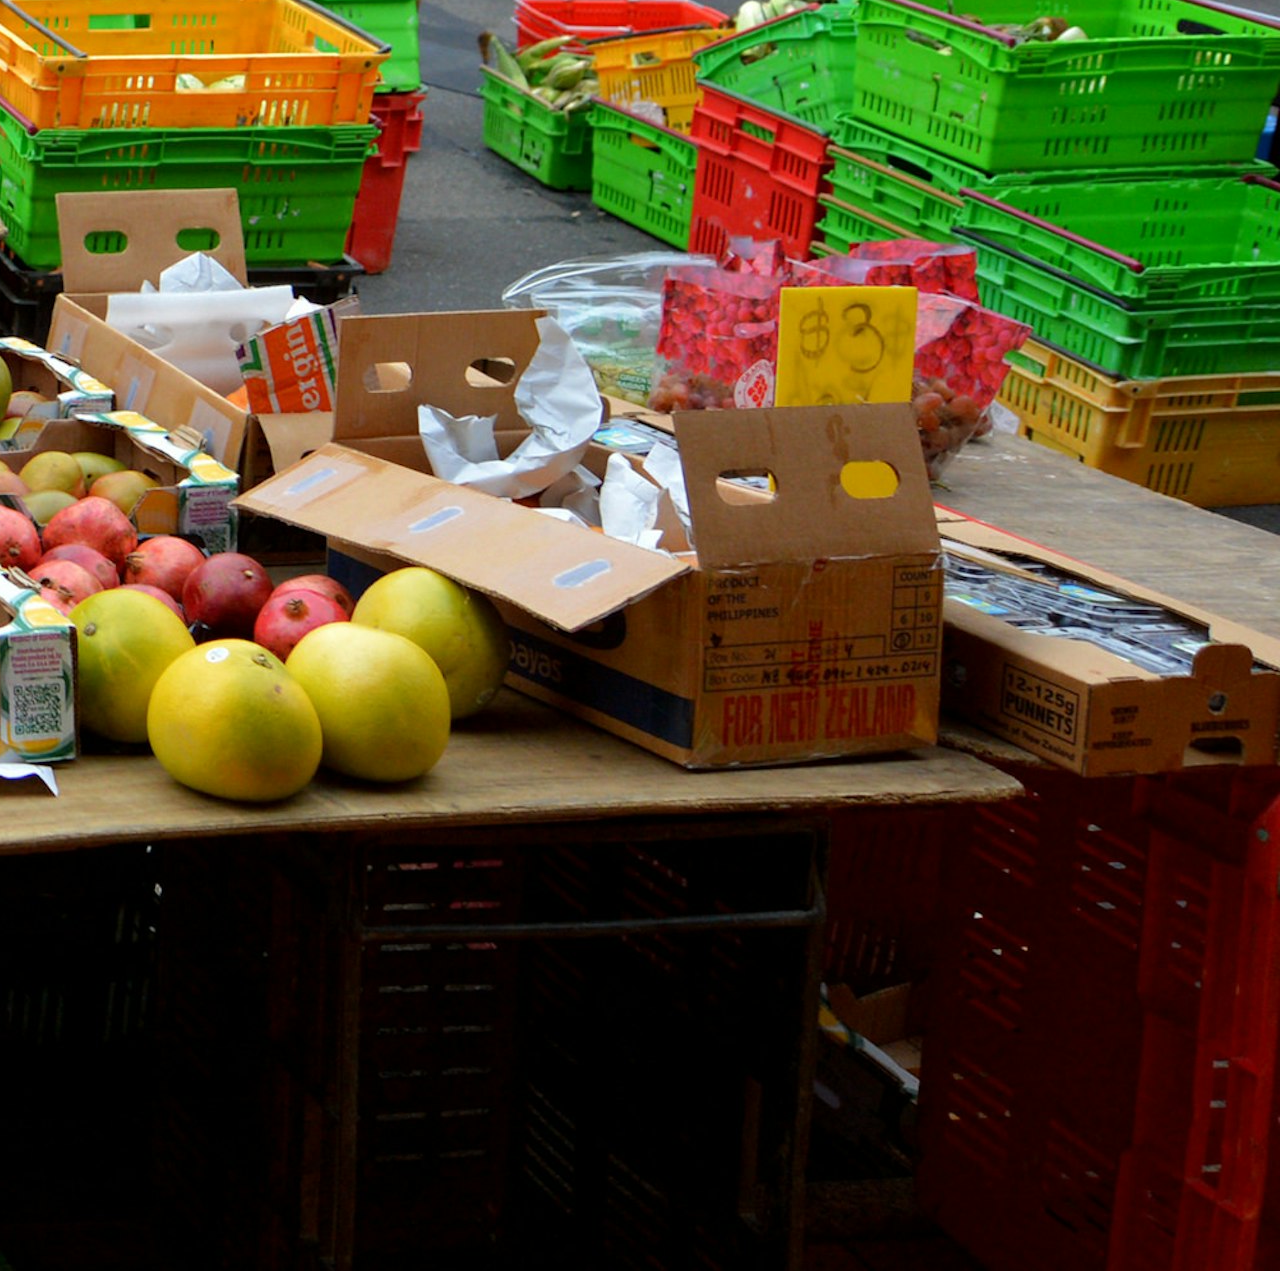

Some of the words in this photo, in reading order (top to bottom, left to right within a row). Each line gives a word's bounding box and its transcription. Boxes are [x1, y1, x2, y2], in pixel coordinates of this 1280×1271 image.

[799, 297, 886, 373] $3
[709, 576, 760, 589] PRODUCT
[900, 569, 934, 581] COUNT
[708, 594, 722, 606] OF
[726, 593, 747, 604] THE
[707, 607, 780, 622] PHILIPPINES
[1007, 672, 1075, 716] 12-125g
[723, 695, 763, 747] FOR
[769, 689, 820, 744] NEW
[824, 684, 916, 740] ZEALAND
[1005, 692, 1074, 737] PUNNETS
